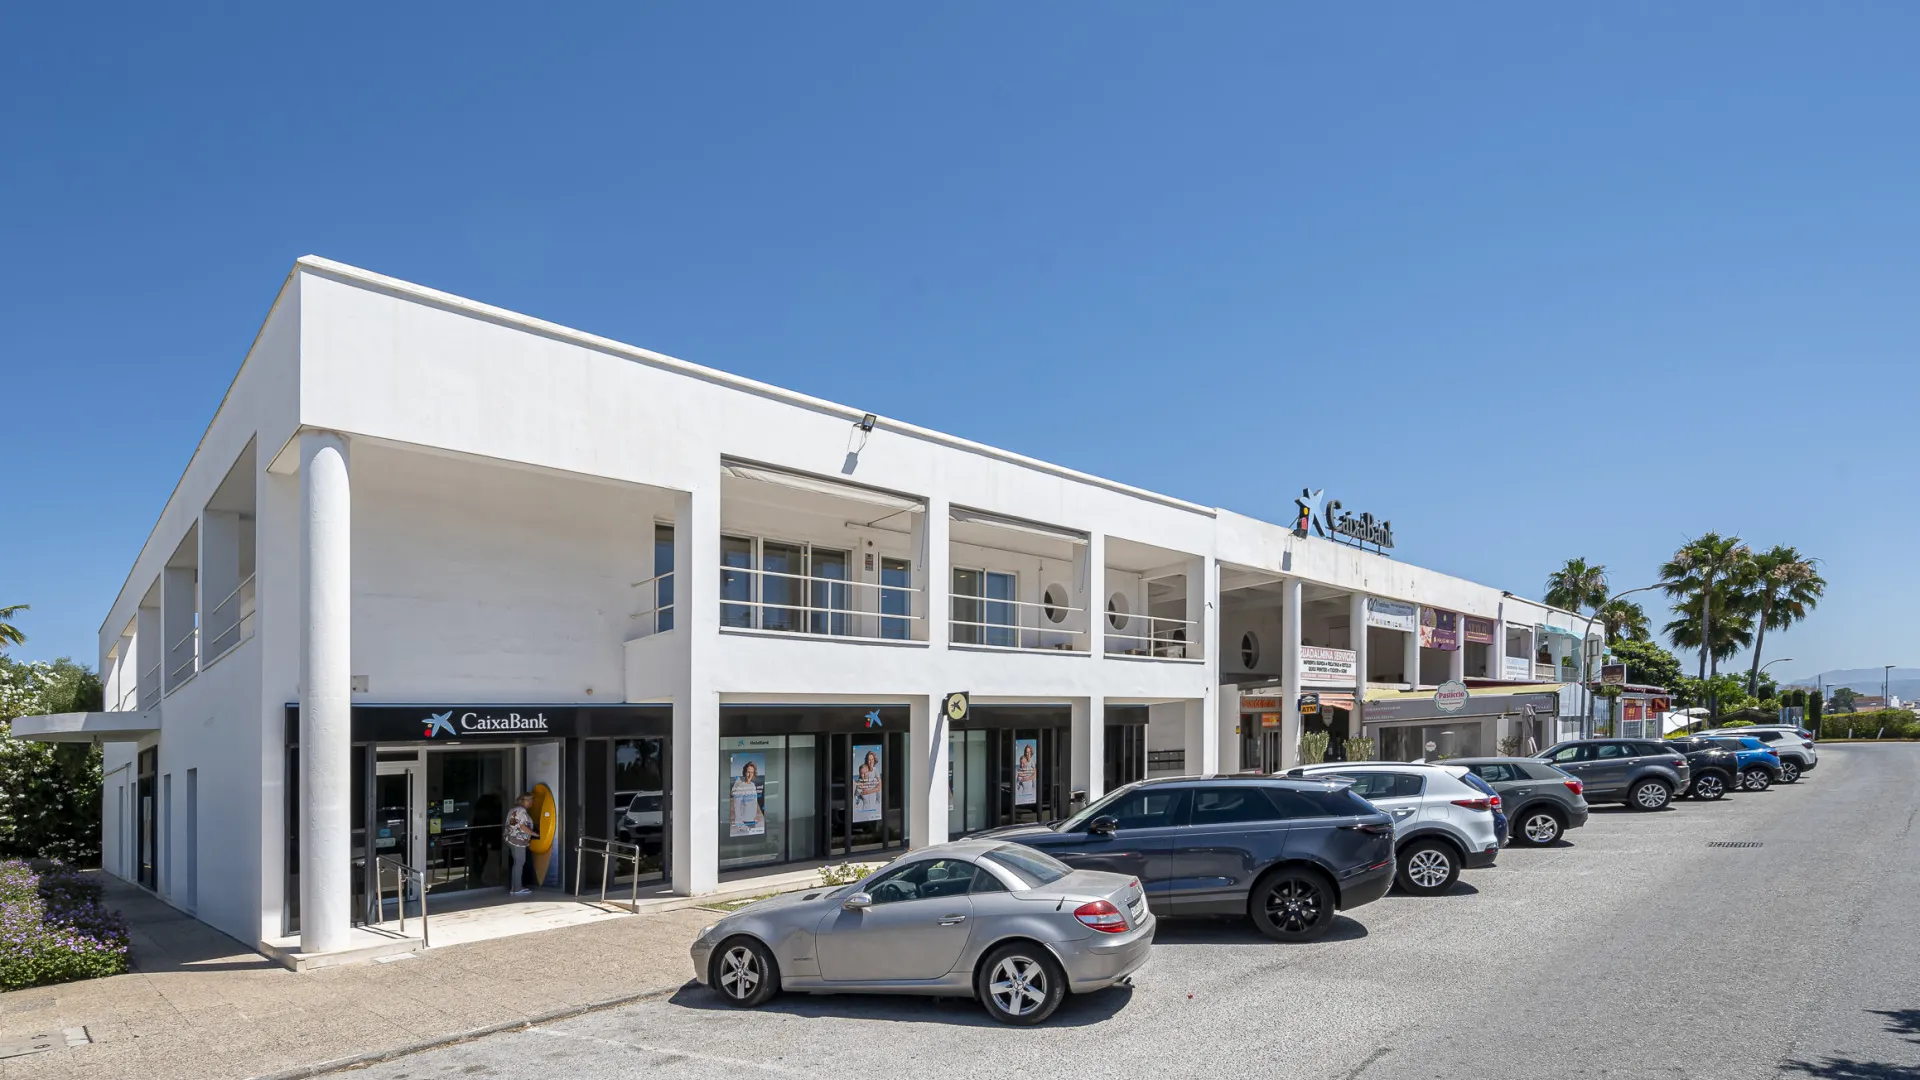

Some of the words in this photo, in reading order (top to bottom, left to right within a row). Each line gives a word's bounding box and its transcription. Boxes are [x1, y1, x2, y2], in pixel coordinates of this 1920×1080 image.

[1326, 500, 1394, 548] CaixaBank
[1301, 705, 1317, 713] ATM
[461, 712, 548, 729] CaixaBank
